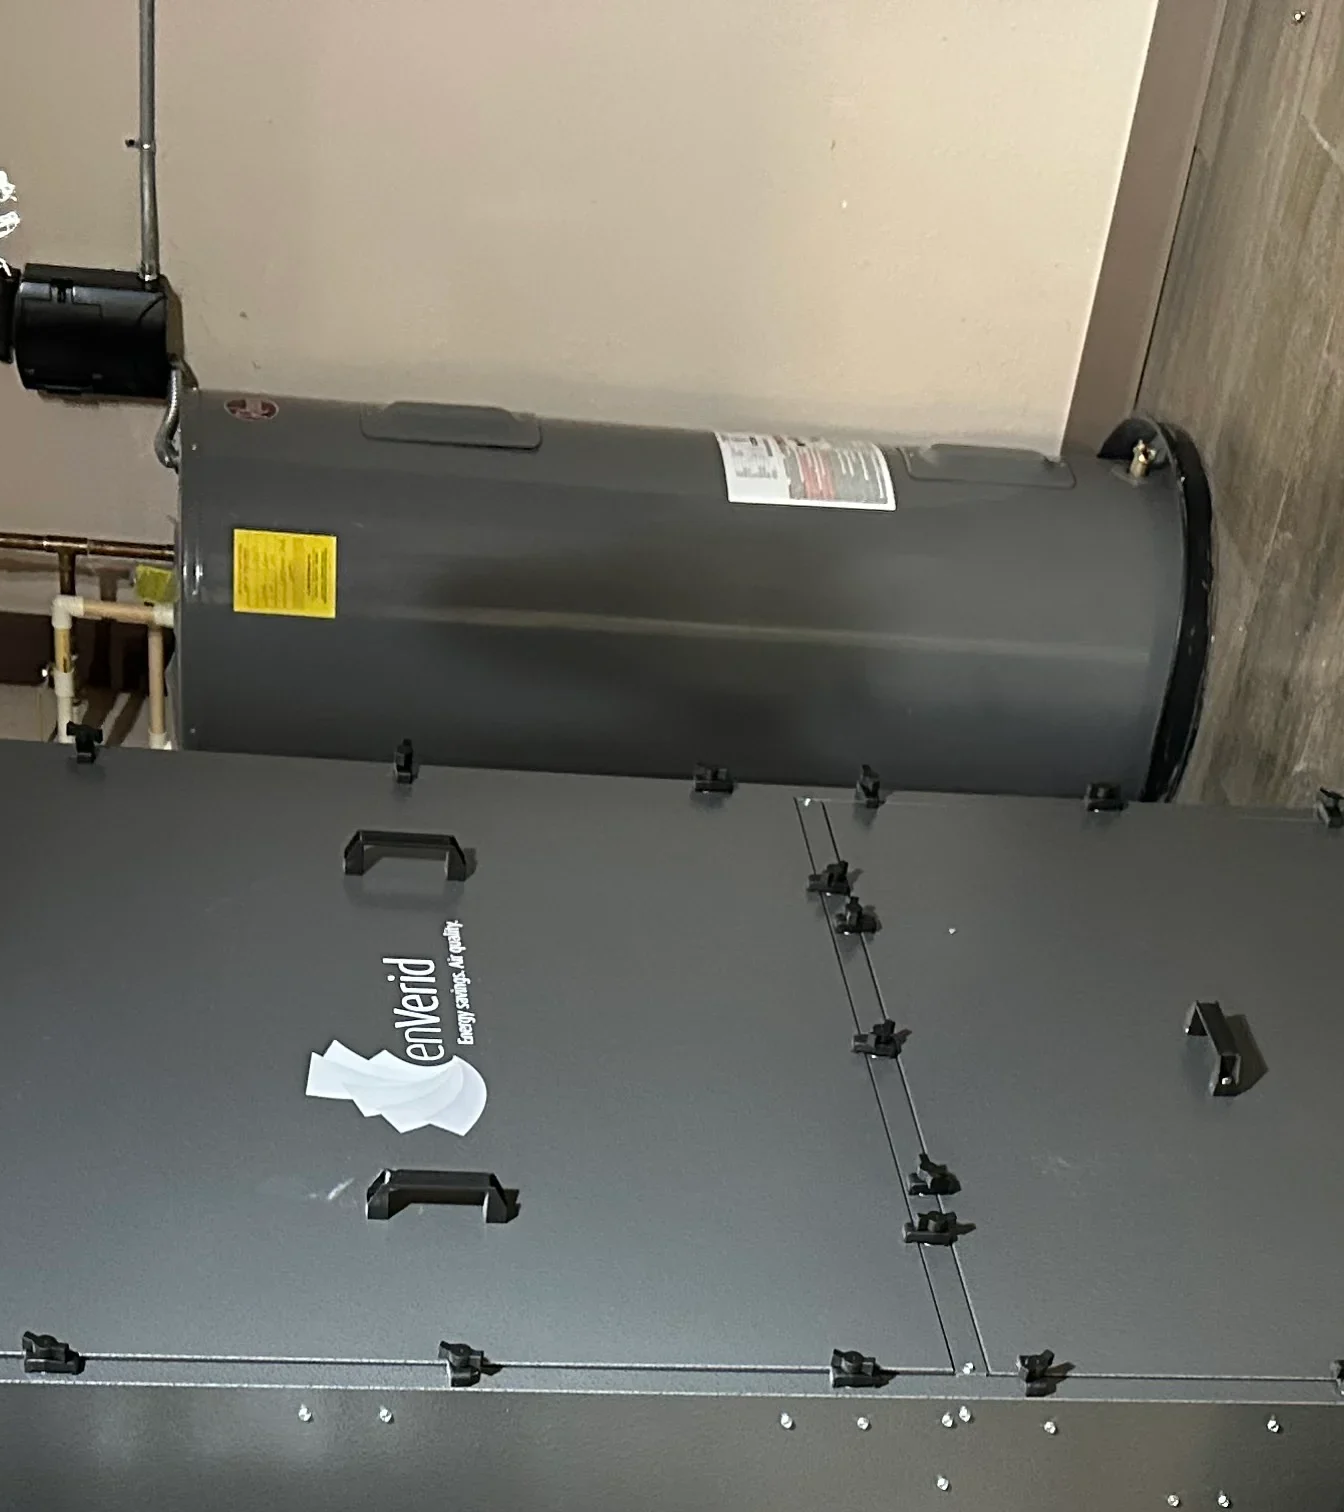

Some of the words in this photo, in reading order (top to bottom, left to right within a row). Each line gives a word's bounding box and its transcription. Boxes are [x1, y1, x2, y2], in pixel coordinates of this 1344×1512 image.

[442, 920, 466, 953] quality.
[446, 953, 465, 969] Air
[449, 970, 471, 1010] savings.
[382, 957, 445, 1061] enVerid
[456, 1010, 476, 1045] Energy
